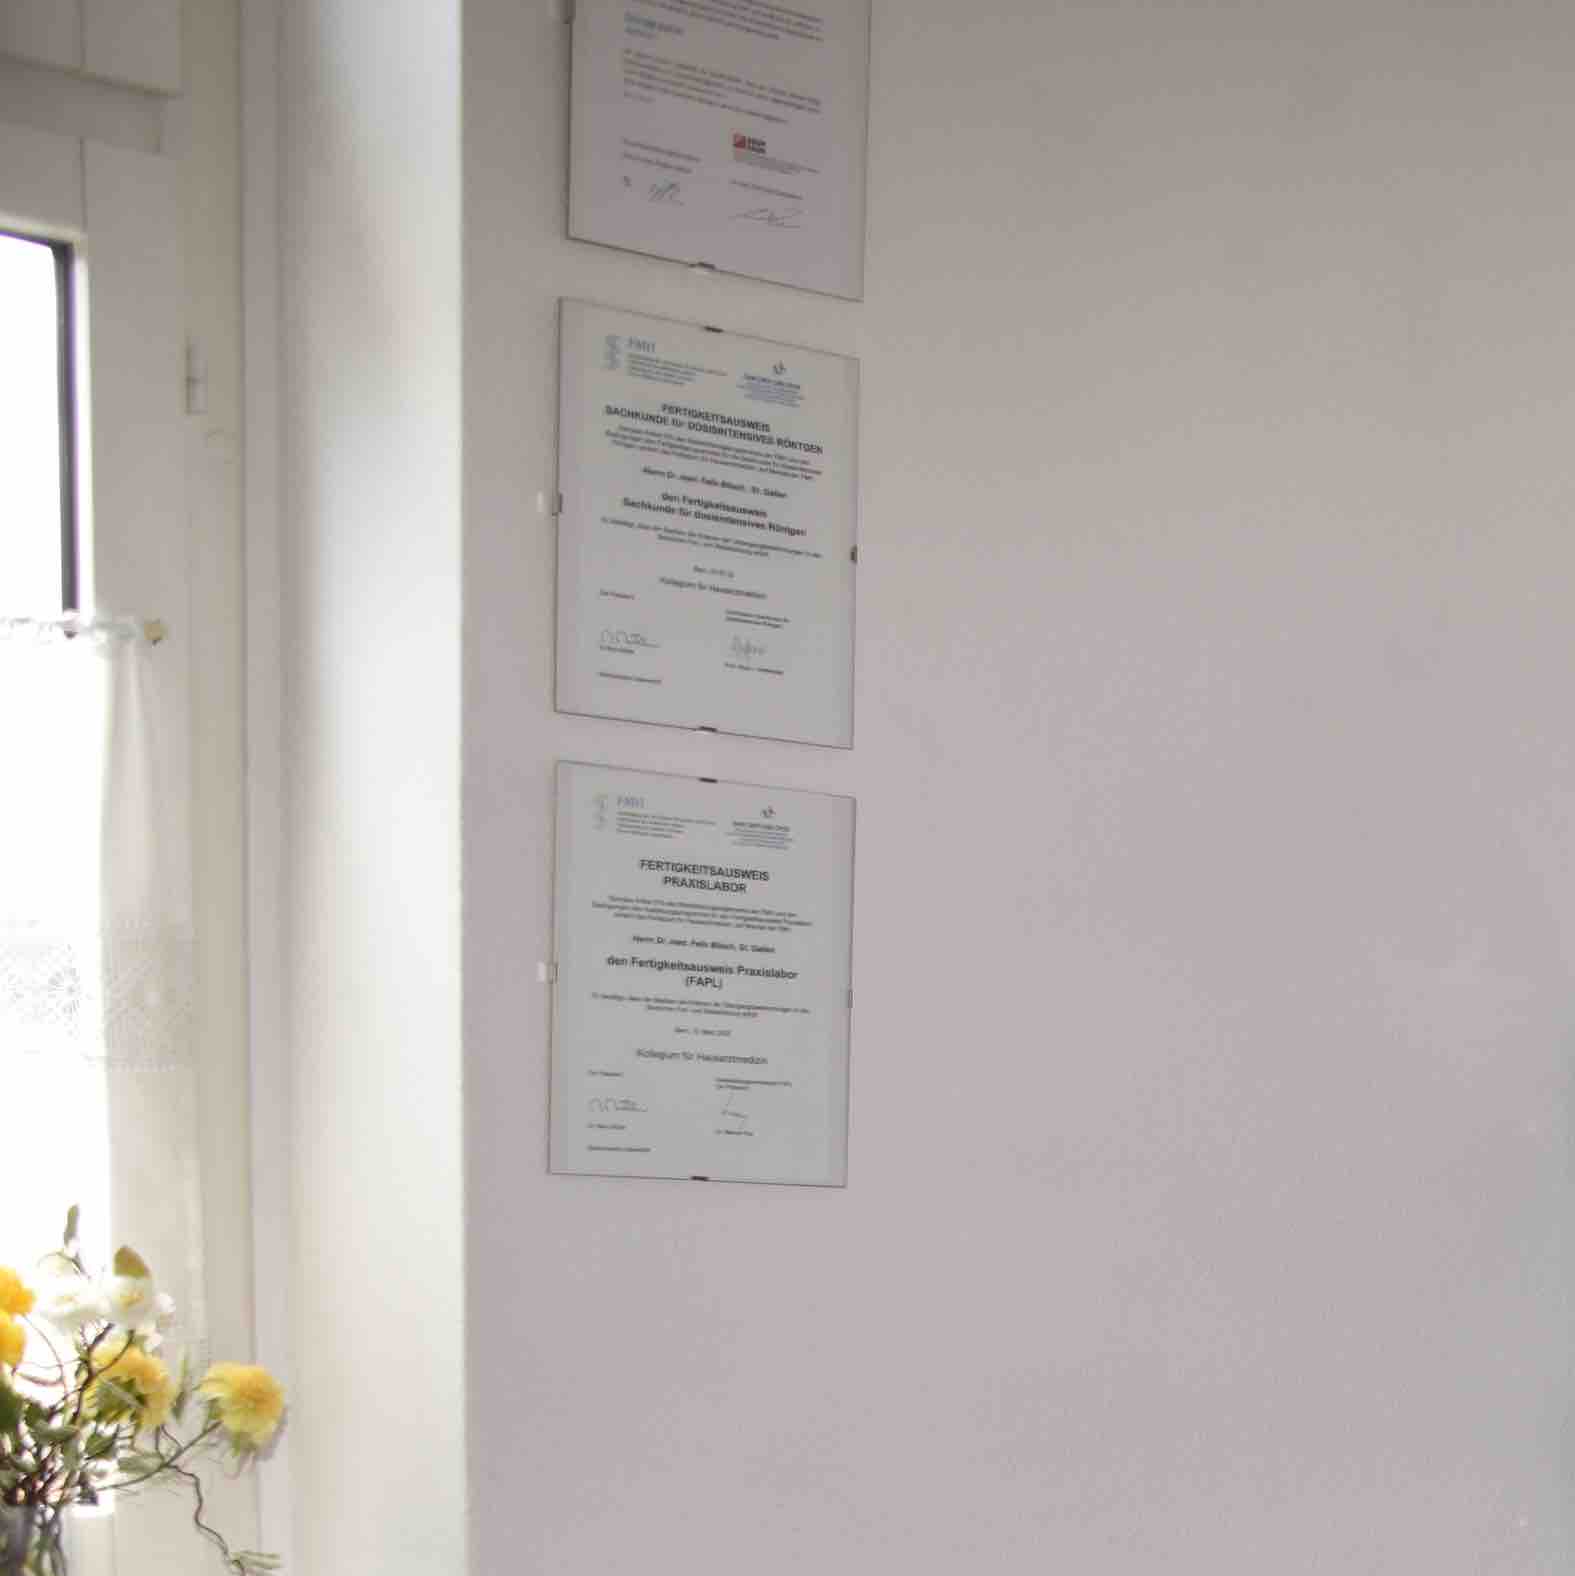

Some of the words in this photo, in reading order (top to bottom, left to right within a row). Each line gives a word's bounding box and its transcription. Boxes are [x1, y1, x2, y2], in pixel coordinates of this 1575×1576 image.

[605, 405, 669, 426] SACHKUNDE
[662, 403, 771, 433] FERTIGKEITSAUSWEIS
[639, 859, 770, 882] FERTIGKEITSAUSWEIS
[662, 875, 747, 894] PRAXISLABOR
[606, 955, 628, 966] den
[631, 956, 734, 975] Fertigkeitsausweis
[737, 964, 799, 980] Praxislabor
[685, 975, 723, 990] (FAPL)
